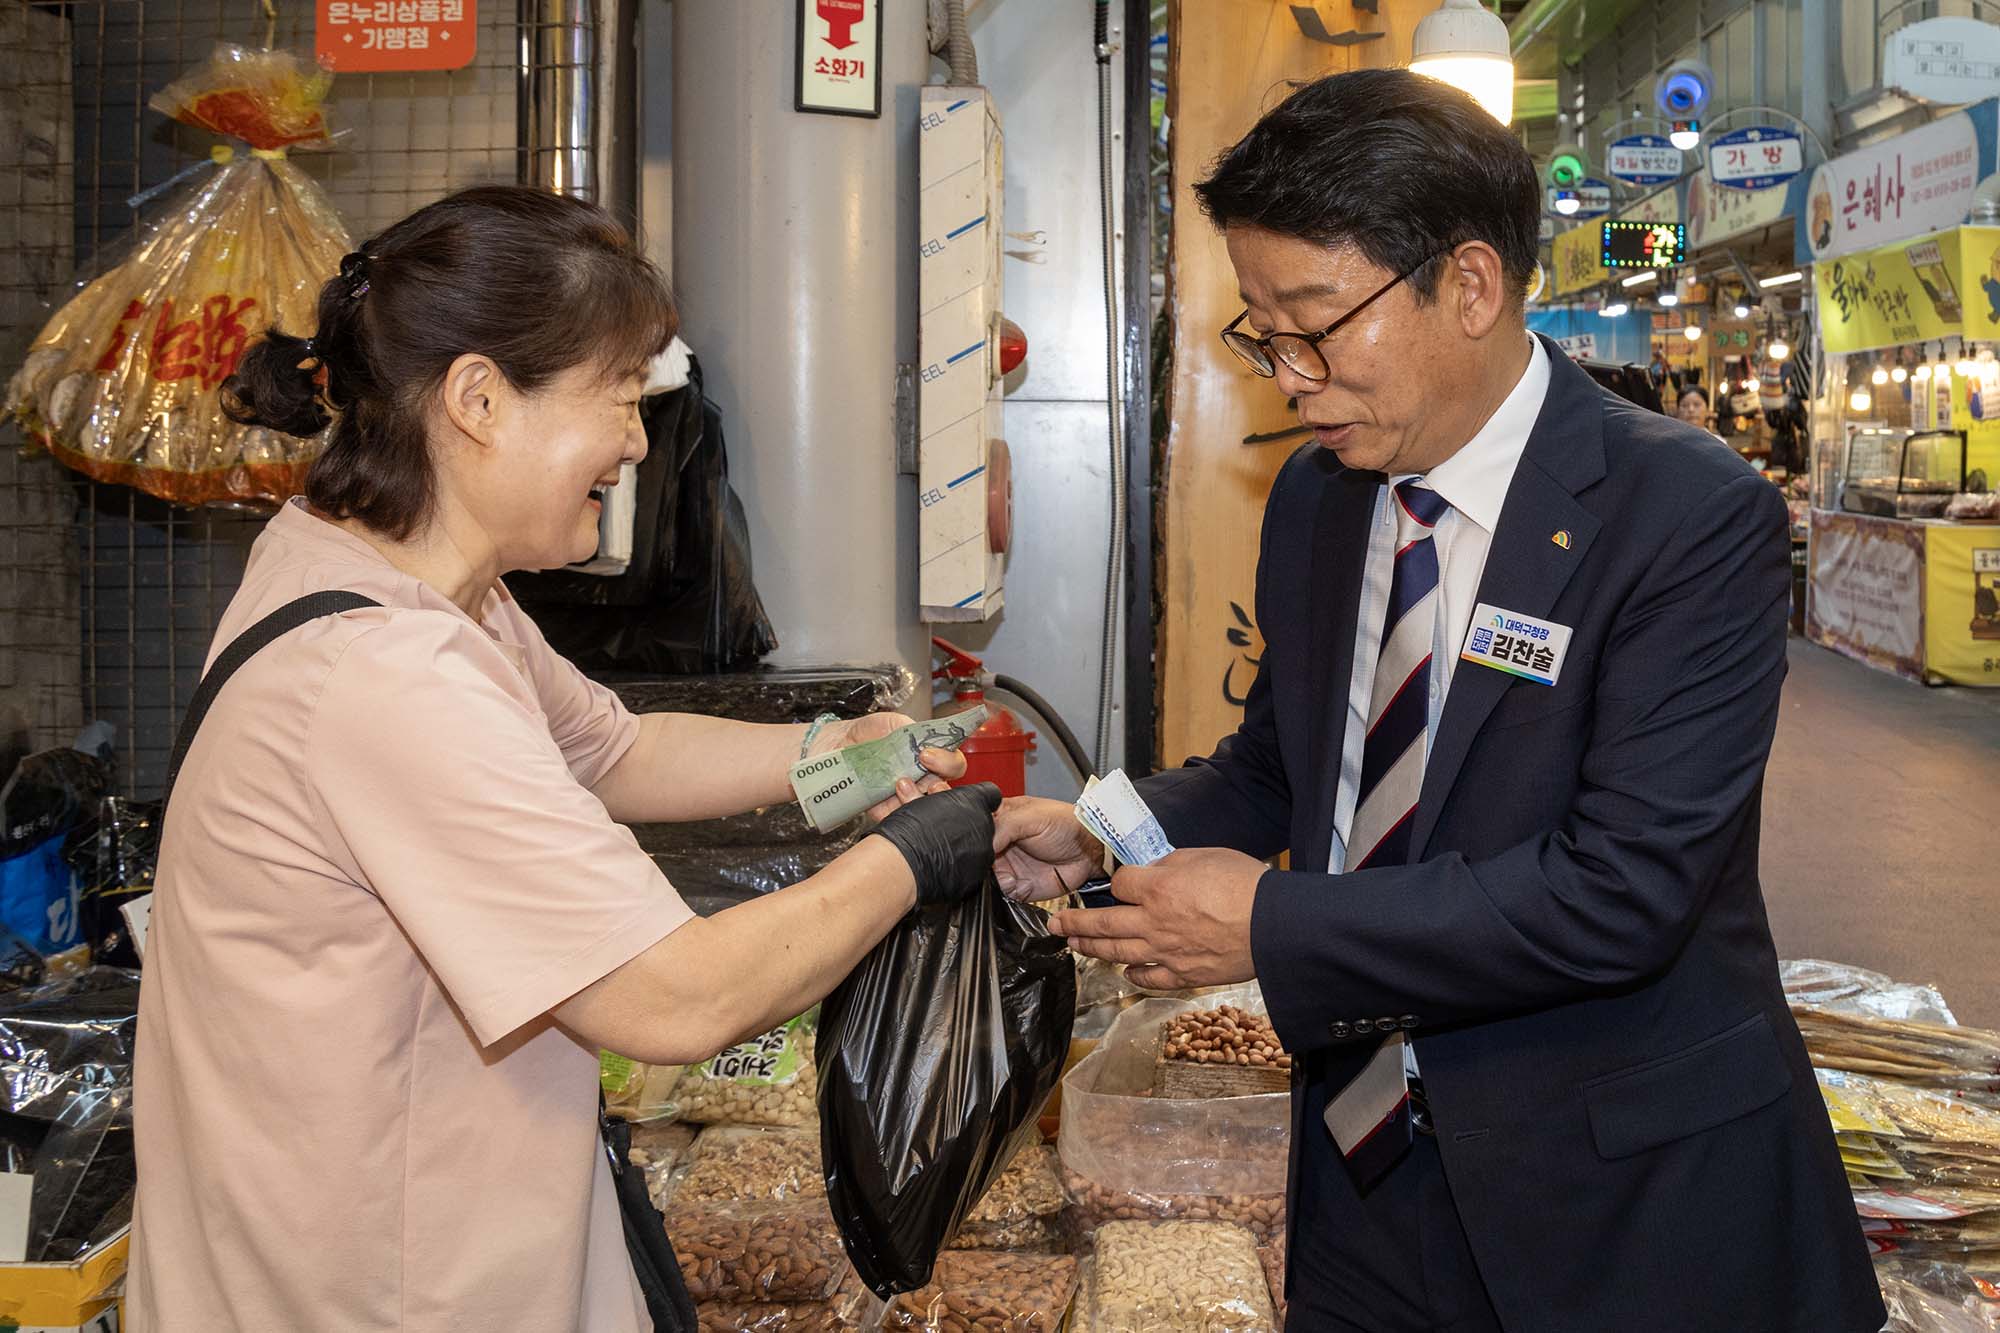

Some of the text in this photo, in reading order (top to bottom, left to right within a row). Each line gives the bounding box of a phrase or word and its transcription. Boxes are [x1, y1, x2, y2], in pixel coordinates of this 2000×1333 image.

[328, 0, 464, 24] 온누리상품권
[361, 27, 429, 49] 가맹점
[814, 56, 864, 79] 소화기
[1505, 619, 1550, 640] 대덕구청장
[1491, 633, 1555, 673] 김찬술
[796, 756, 841, 779] 10000
[813, 776, 855, 804] 10000
[1096, 807, 1124, 843] 1000
